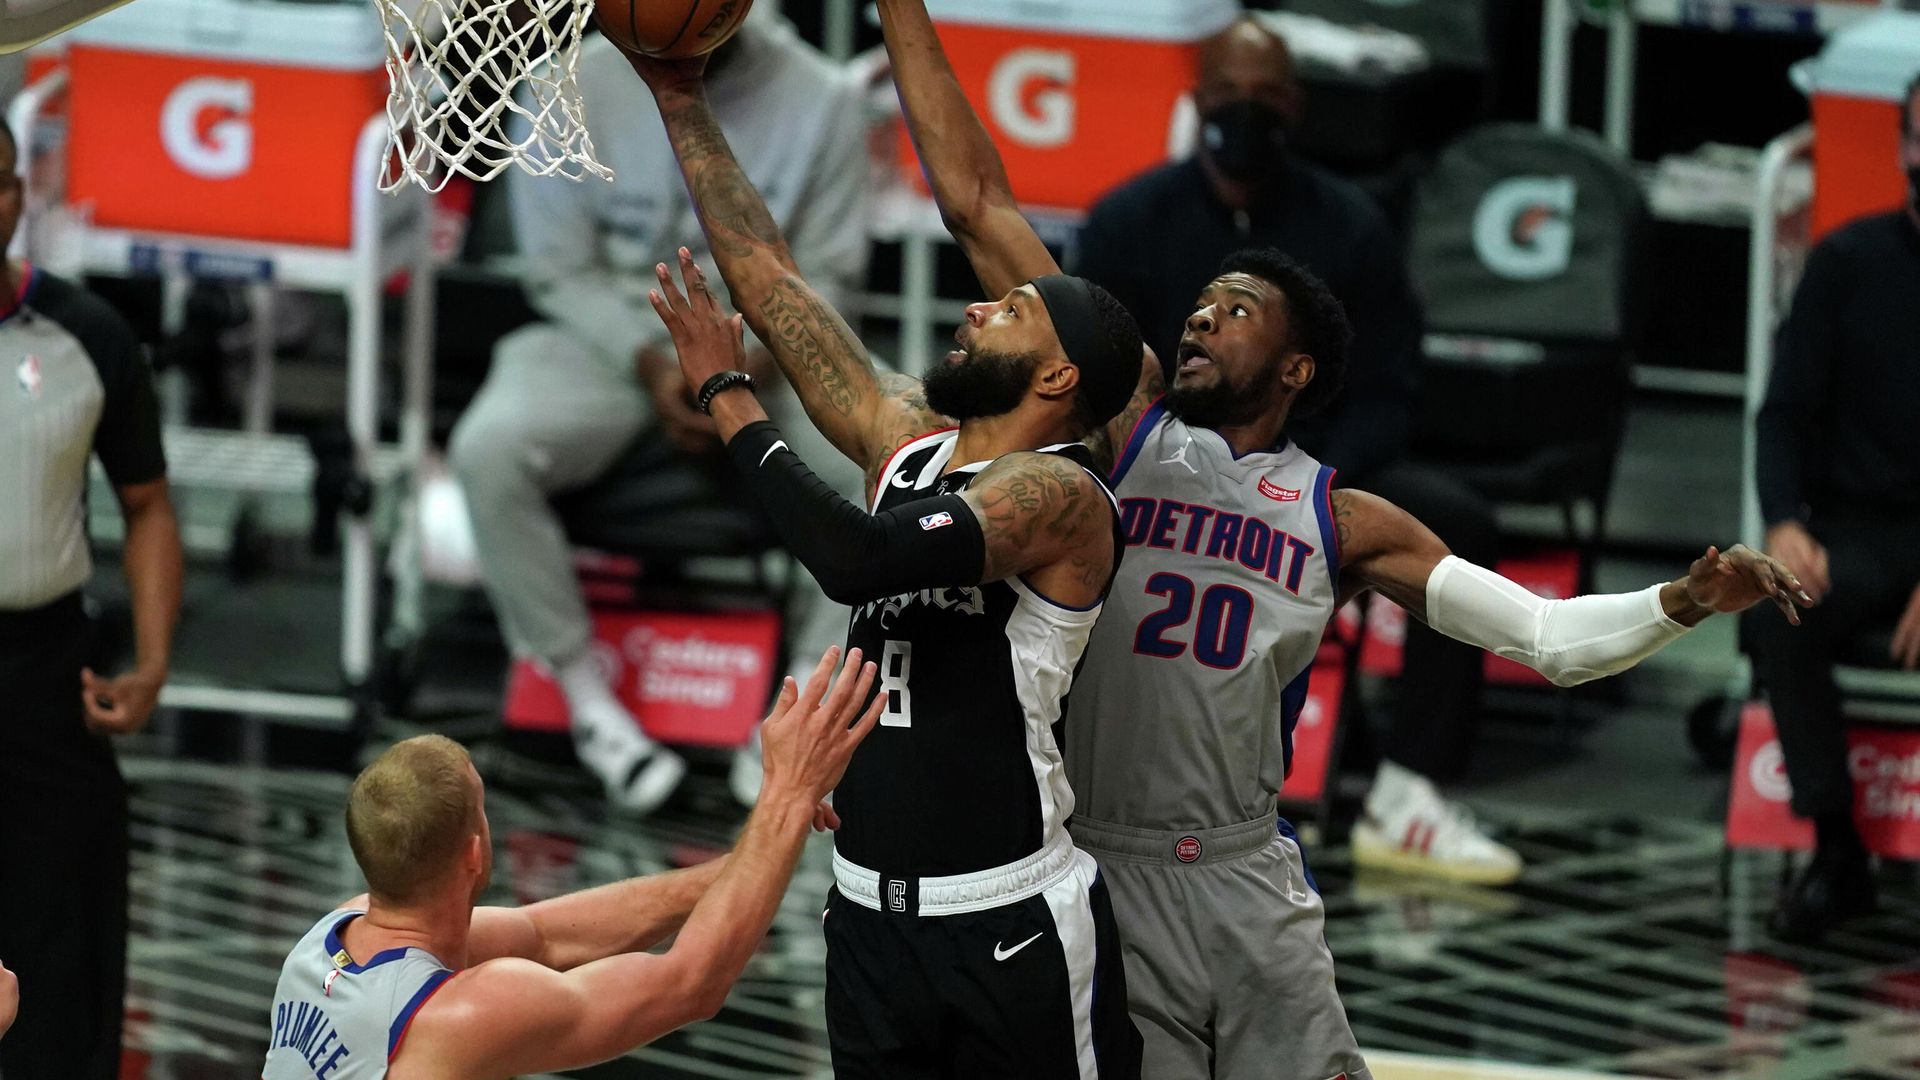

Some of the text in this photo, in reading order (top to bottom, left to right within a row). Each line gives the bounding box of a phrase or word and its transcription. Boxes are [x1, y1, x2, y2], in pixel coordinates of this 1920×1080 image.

[160, 77, 253, 179] G
[985, 47, 1076, 148] G
[1473, 176, 1575, 279] G
[1261, 479, 1298, 497] Flagstar
[1120, 497, 1314, 597] DETROIT
[1133, 571, 1254, 670] 20
[880, 640, 912, 728] 8
[272, 1001, 350, 1080] PLUMLEE
